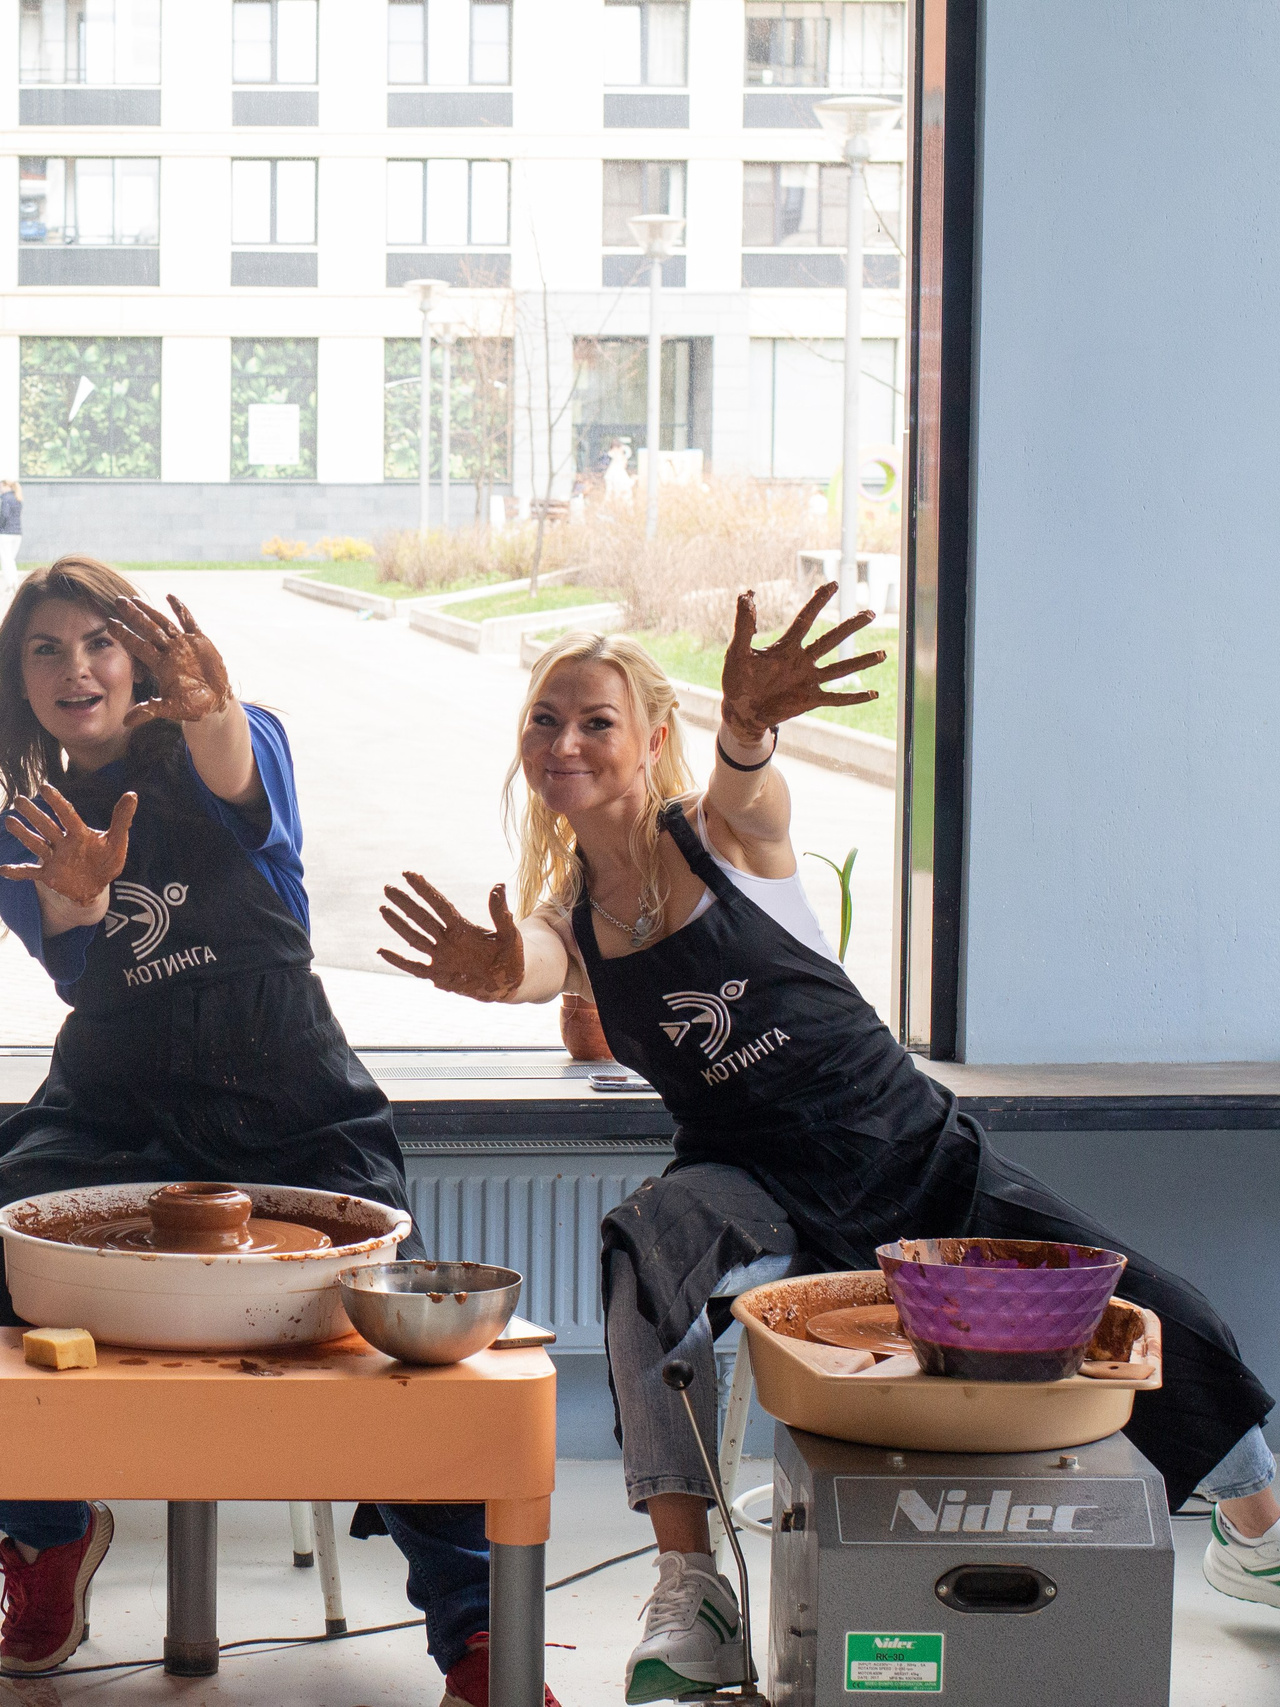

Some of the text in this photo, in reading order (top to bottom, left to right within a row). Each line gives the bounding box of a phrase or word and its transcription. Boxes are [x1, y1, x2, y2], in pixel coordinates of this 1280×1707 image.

[123, 945, 217, 987] КОТИНГА
[700, 1027, 791, 1086] КОТИНГА
[889, 1489, 1099, 1533] Nidec
[872, 1637, 917, 1649] Nidec
[875, 1653, 904, 1661] RK-3D
